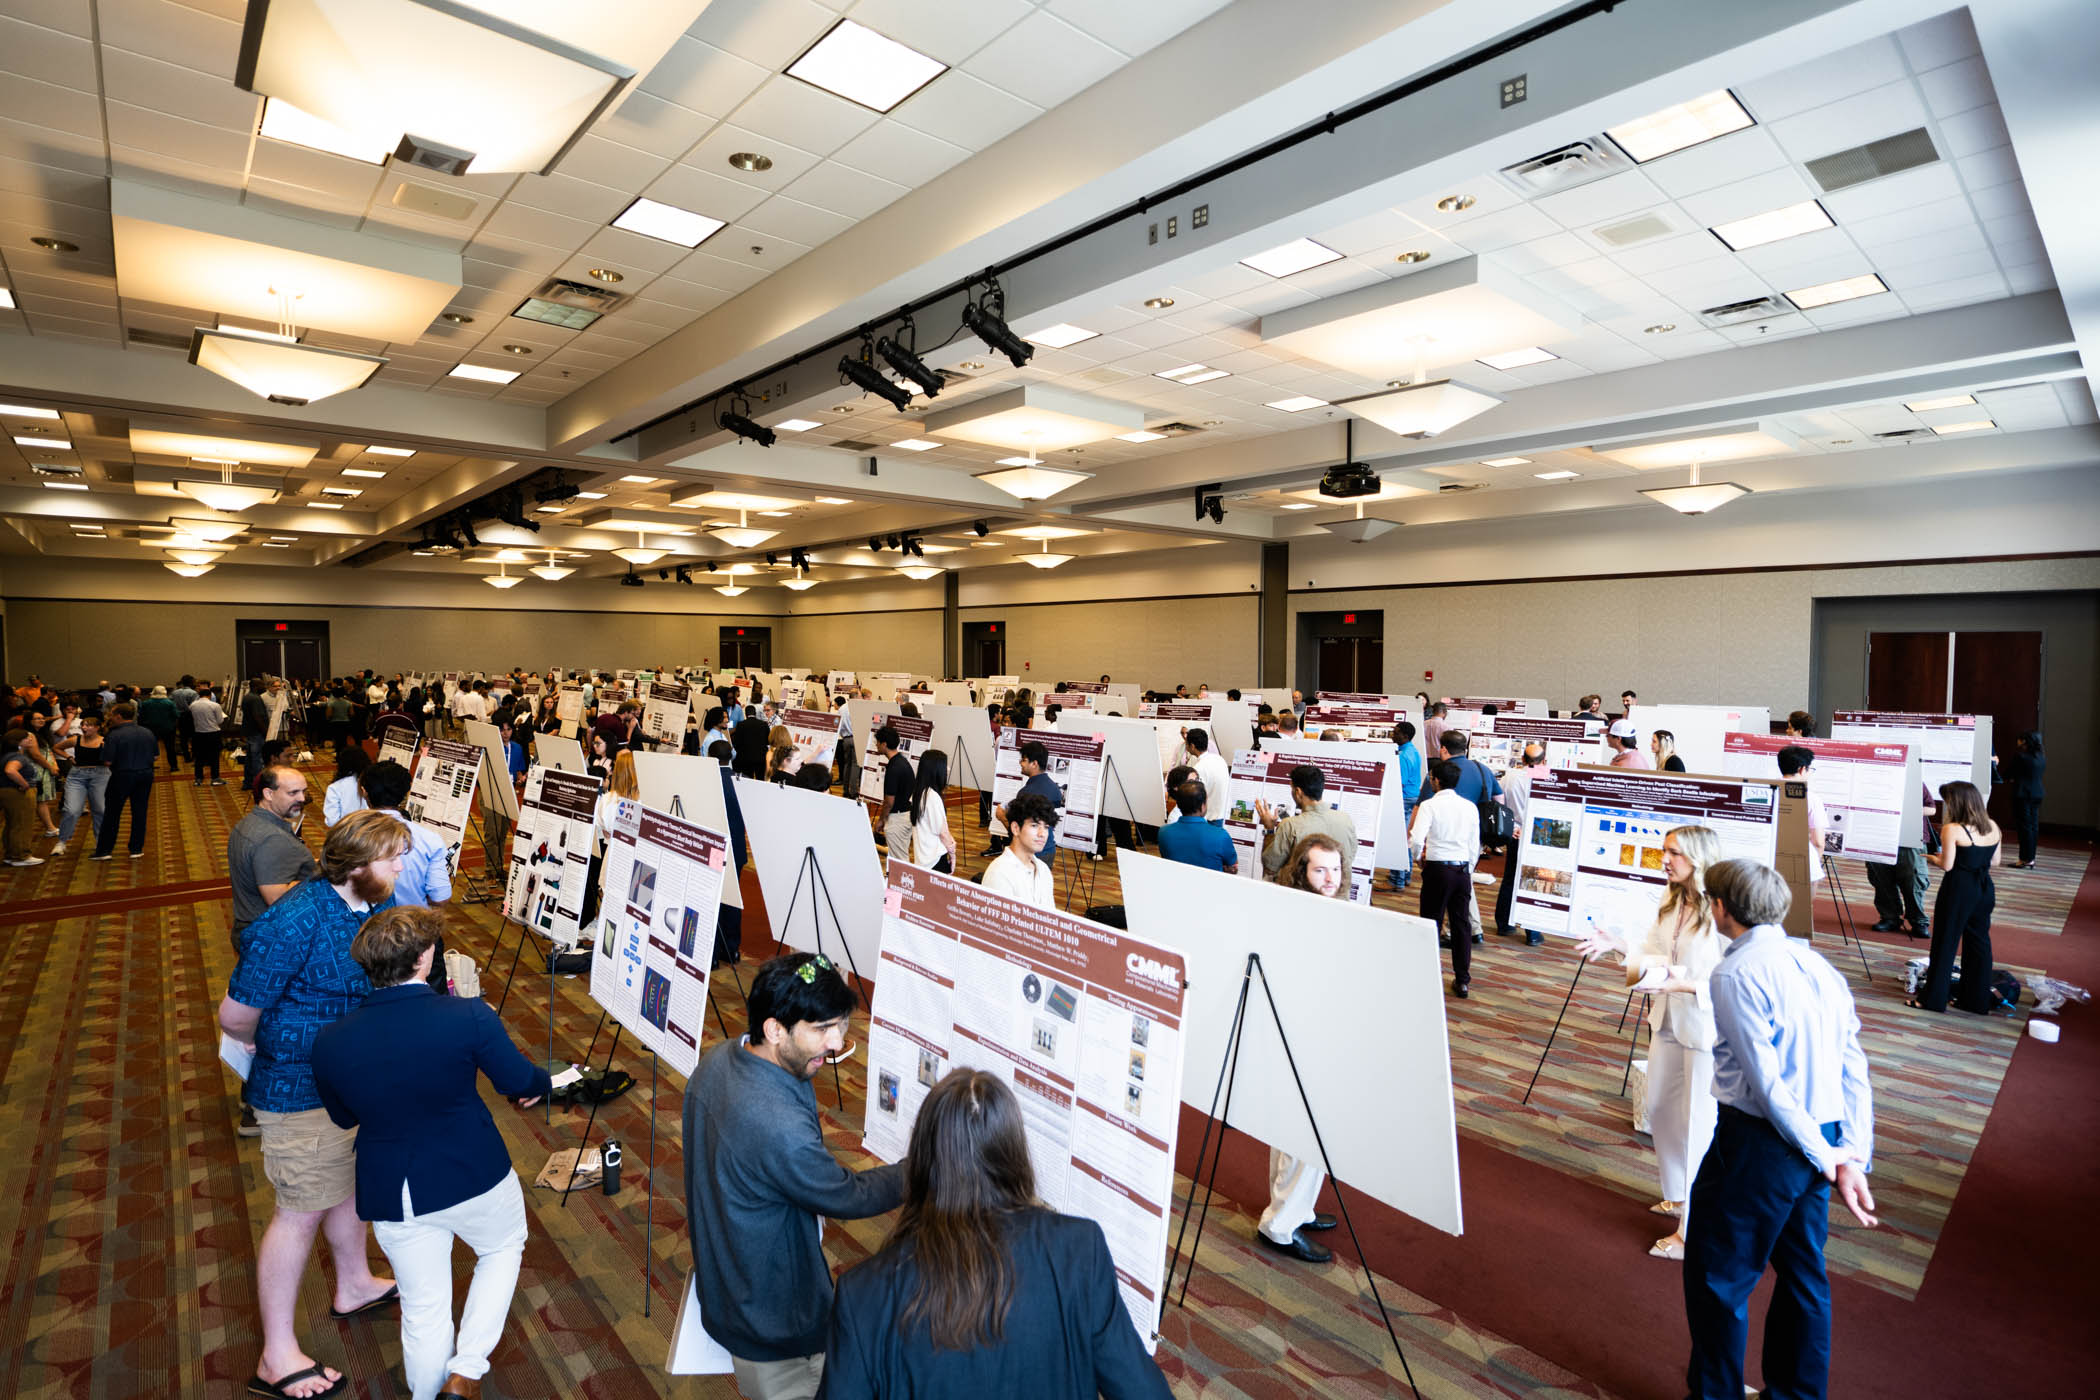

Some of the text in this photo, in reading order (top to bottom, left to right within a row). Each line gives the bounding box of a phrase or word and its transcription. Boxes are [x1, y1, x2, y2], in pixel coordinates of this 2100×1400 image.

[930, 876, 947, 888] Effects
[947, 883, 954, 891] of
[953, 883, 970, 896] Water
[971, 890, 1002, 906] Absorption
[1011, 903, 1021, 914] the
[1022, 906, 1058, 927] Mechanical
[1060, 922, 1072, 932] and
[1074, 925, 1118, 946] Geometrical
[956, 896, 980, 911] Behavior
[981, 903, 988, 914] of
[1001, 911, 1009, 922] 3D
[1011, 915, 1034, 931] Printed
[1035, 922, 1062, 940] ULTEM
[1063, 934, 1079, 947] 1010
[1005, 953, 1032, 970] Methodology
[1126, 952, 1180, 989] CMML
[1107, 993, 1126, 1008] Testing
[1030, 1062, 1048, 1076] Analysis
[1106, 1111, 1137, 1134] Future Work
[1101, 1174, 1129, 1196] References
